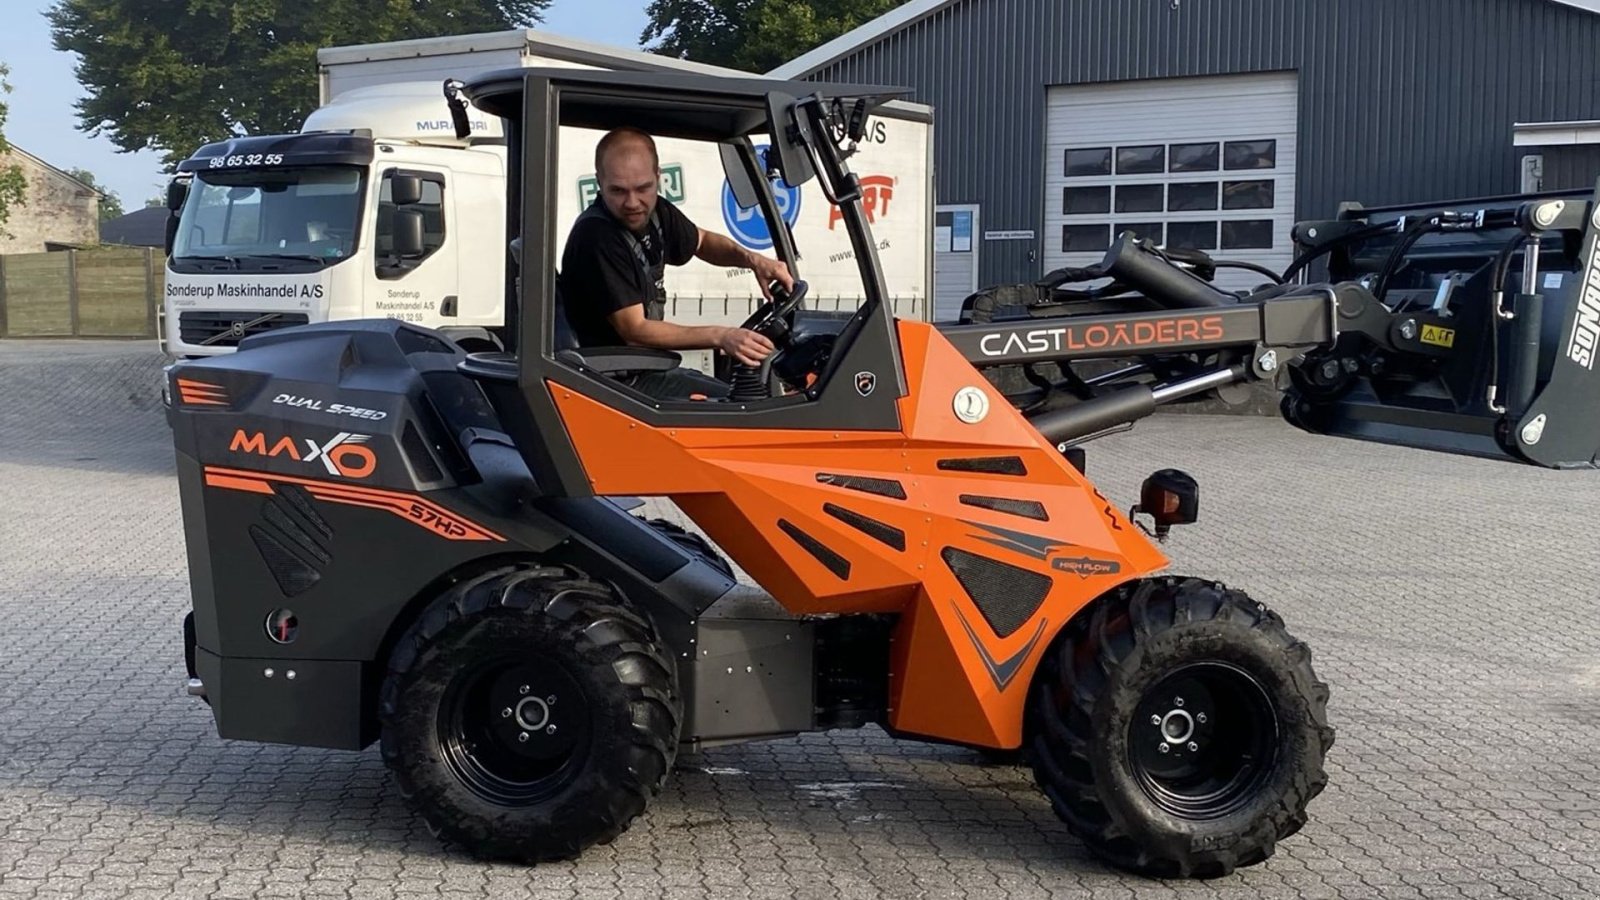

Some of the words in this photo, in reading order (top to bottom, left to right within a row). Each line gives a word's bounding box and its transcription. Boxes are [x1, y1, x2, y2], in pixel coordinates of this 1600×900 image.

[416, 121, 488, 130] MURORI
[209, 157, 225, 168] 98
[227, 156, 244, 166] 65
[248, 154, 262, 165] 32
[265, 154, 284, 164] 55
[166, 283, 214, 298] Sønderup
[217, 284, 297, 298] Maskinhandel
[300, 285, 324, 298] A/S
[376, 302, 422, 310] Maskinhandel
[424, 302, 435, 310] A/S
[1571, 240, 1600, 368] SONAR
[272, 393, 322, 410] DUAL
[326, 403, 387, 421] SPEED
[229, 428, 377, 479] MAXO
[409, 504, 466, 537] 57HP
[1083, 563, 1111, 571] FLOW
